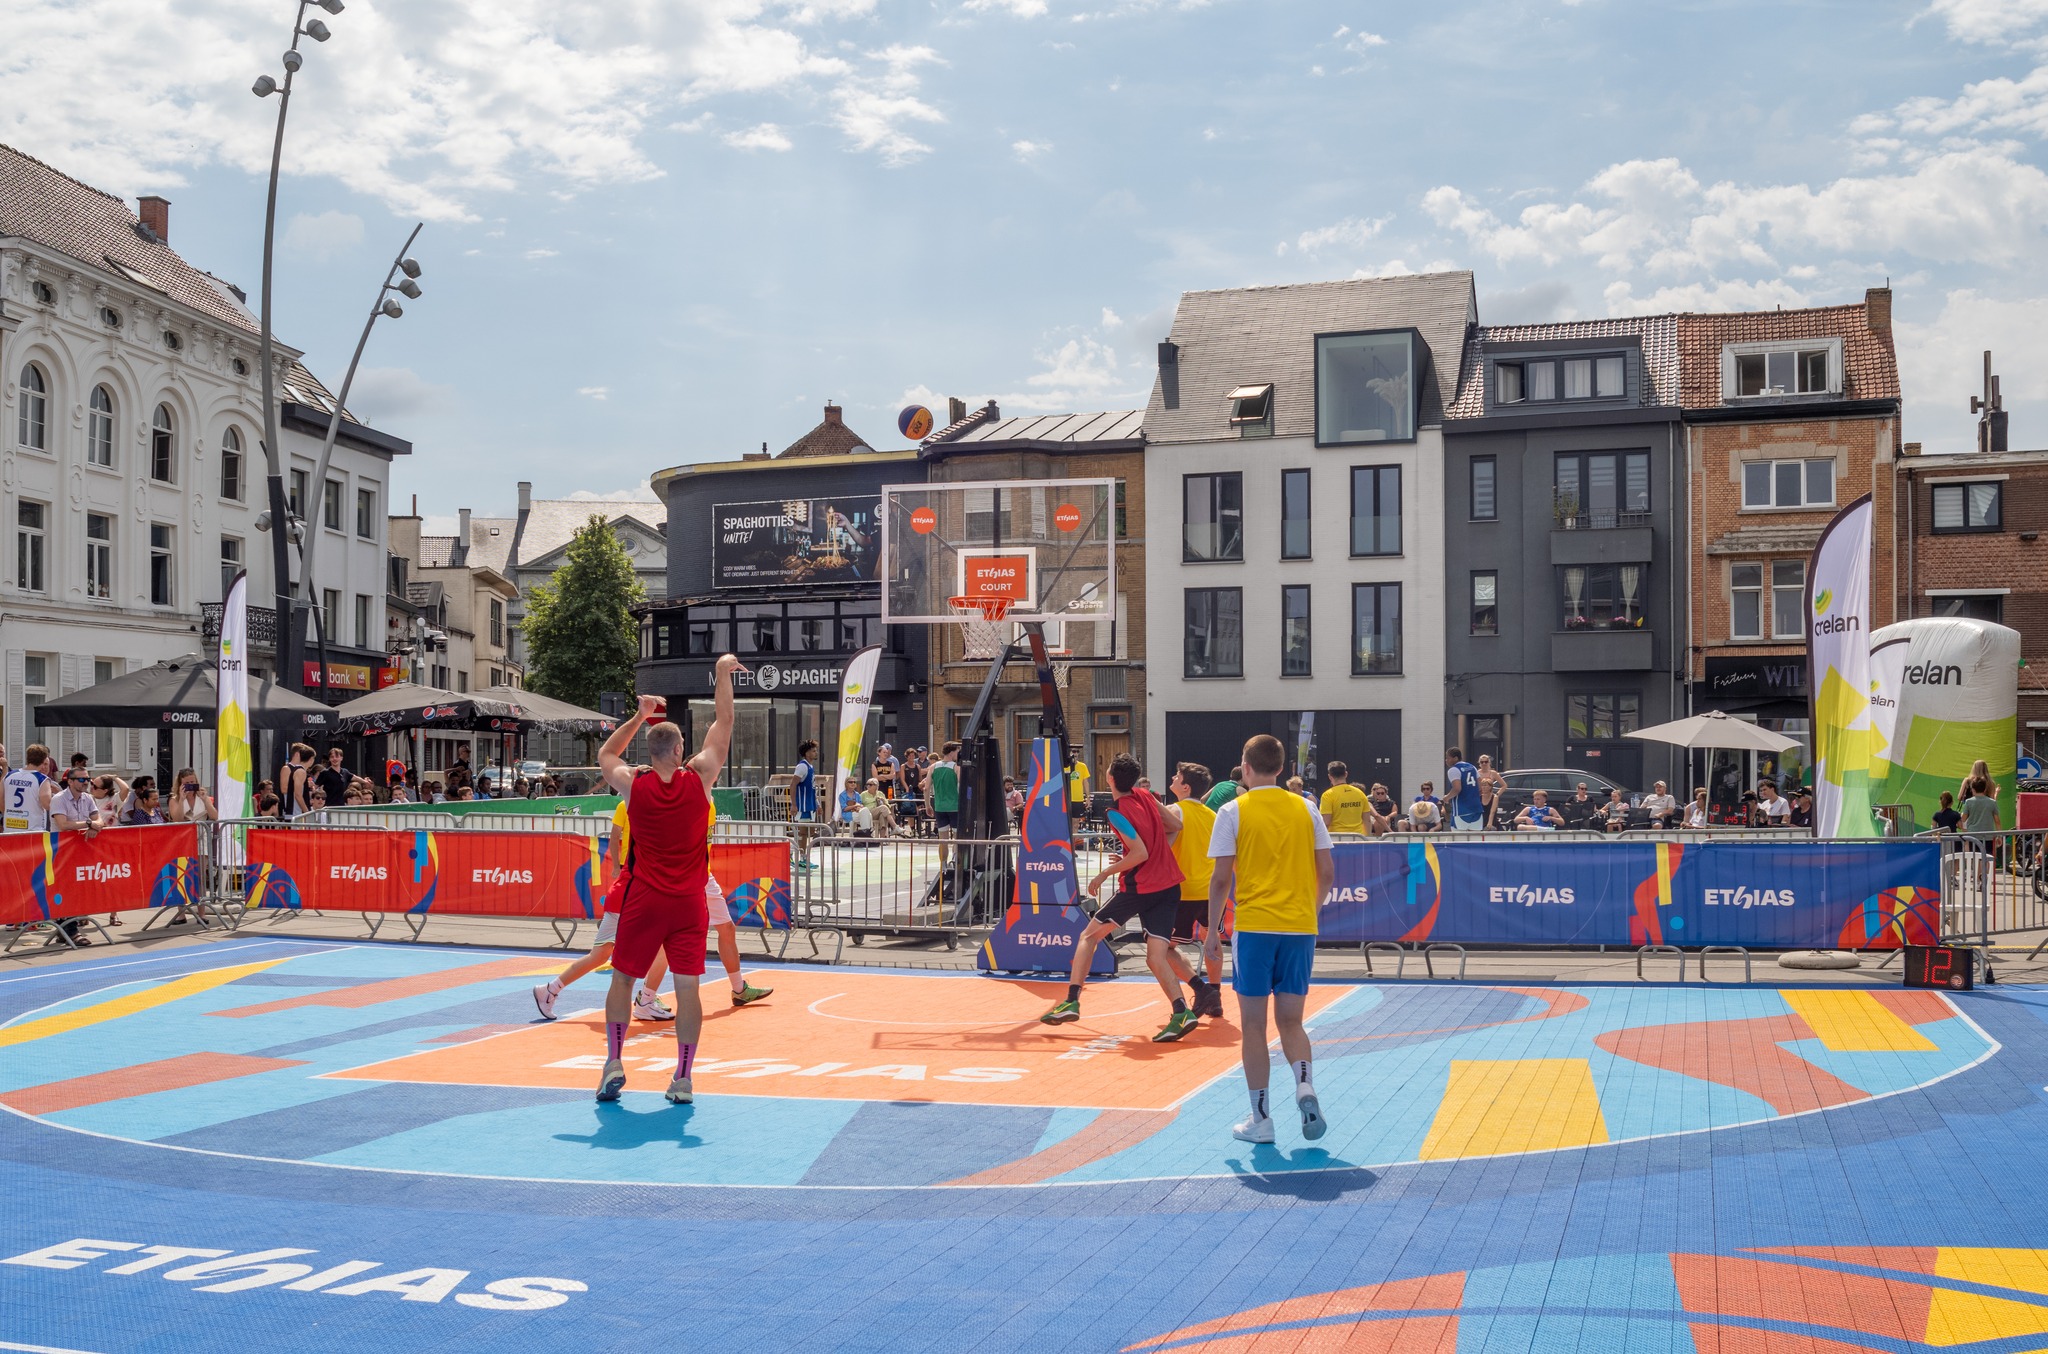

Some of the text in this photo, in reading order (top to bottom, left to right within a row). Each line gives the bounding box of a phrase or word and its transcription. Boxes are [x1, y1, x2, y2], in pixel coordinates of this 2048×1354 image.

[723, 515, 795, 530] SPAGHOTTIES
[723, 530, 754, 545] UNITE!
[977, 568, 1016, 579] ETHIAS
[980, 583, 1013, 591] COURT
[1814, 614, 1860, 637] crelan
[329, 668, 351, 685] bank
[709, 670, 756, 686] MTER
[1466, 772, 1477, 787] 4
[14, 788, 25, 808] 5
[75, 862, 132, 883] ETHIAS
[330, 865, 388, 882] ETHIAS
[1025, 861, 1065, 873] ETHIAS
[472, 867, 534, 886] ETHIAS
[1489, 886, 1575, 907] ETHIAS
[1704, 886, 1796, 909] ETHIAS
[1017, 932, 1073, 948] ETHIAS
[1923, 948, 1953, 985] 12
[0, 1237, 589, 1311] ETHIAS
